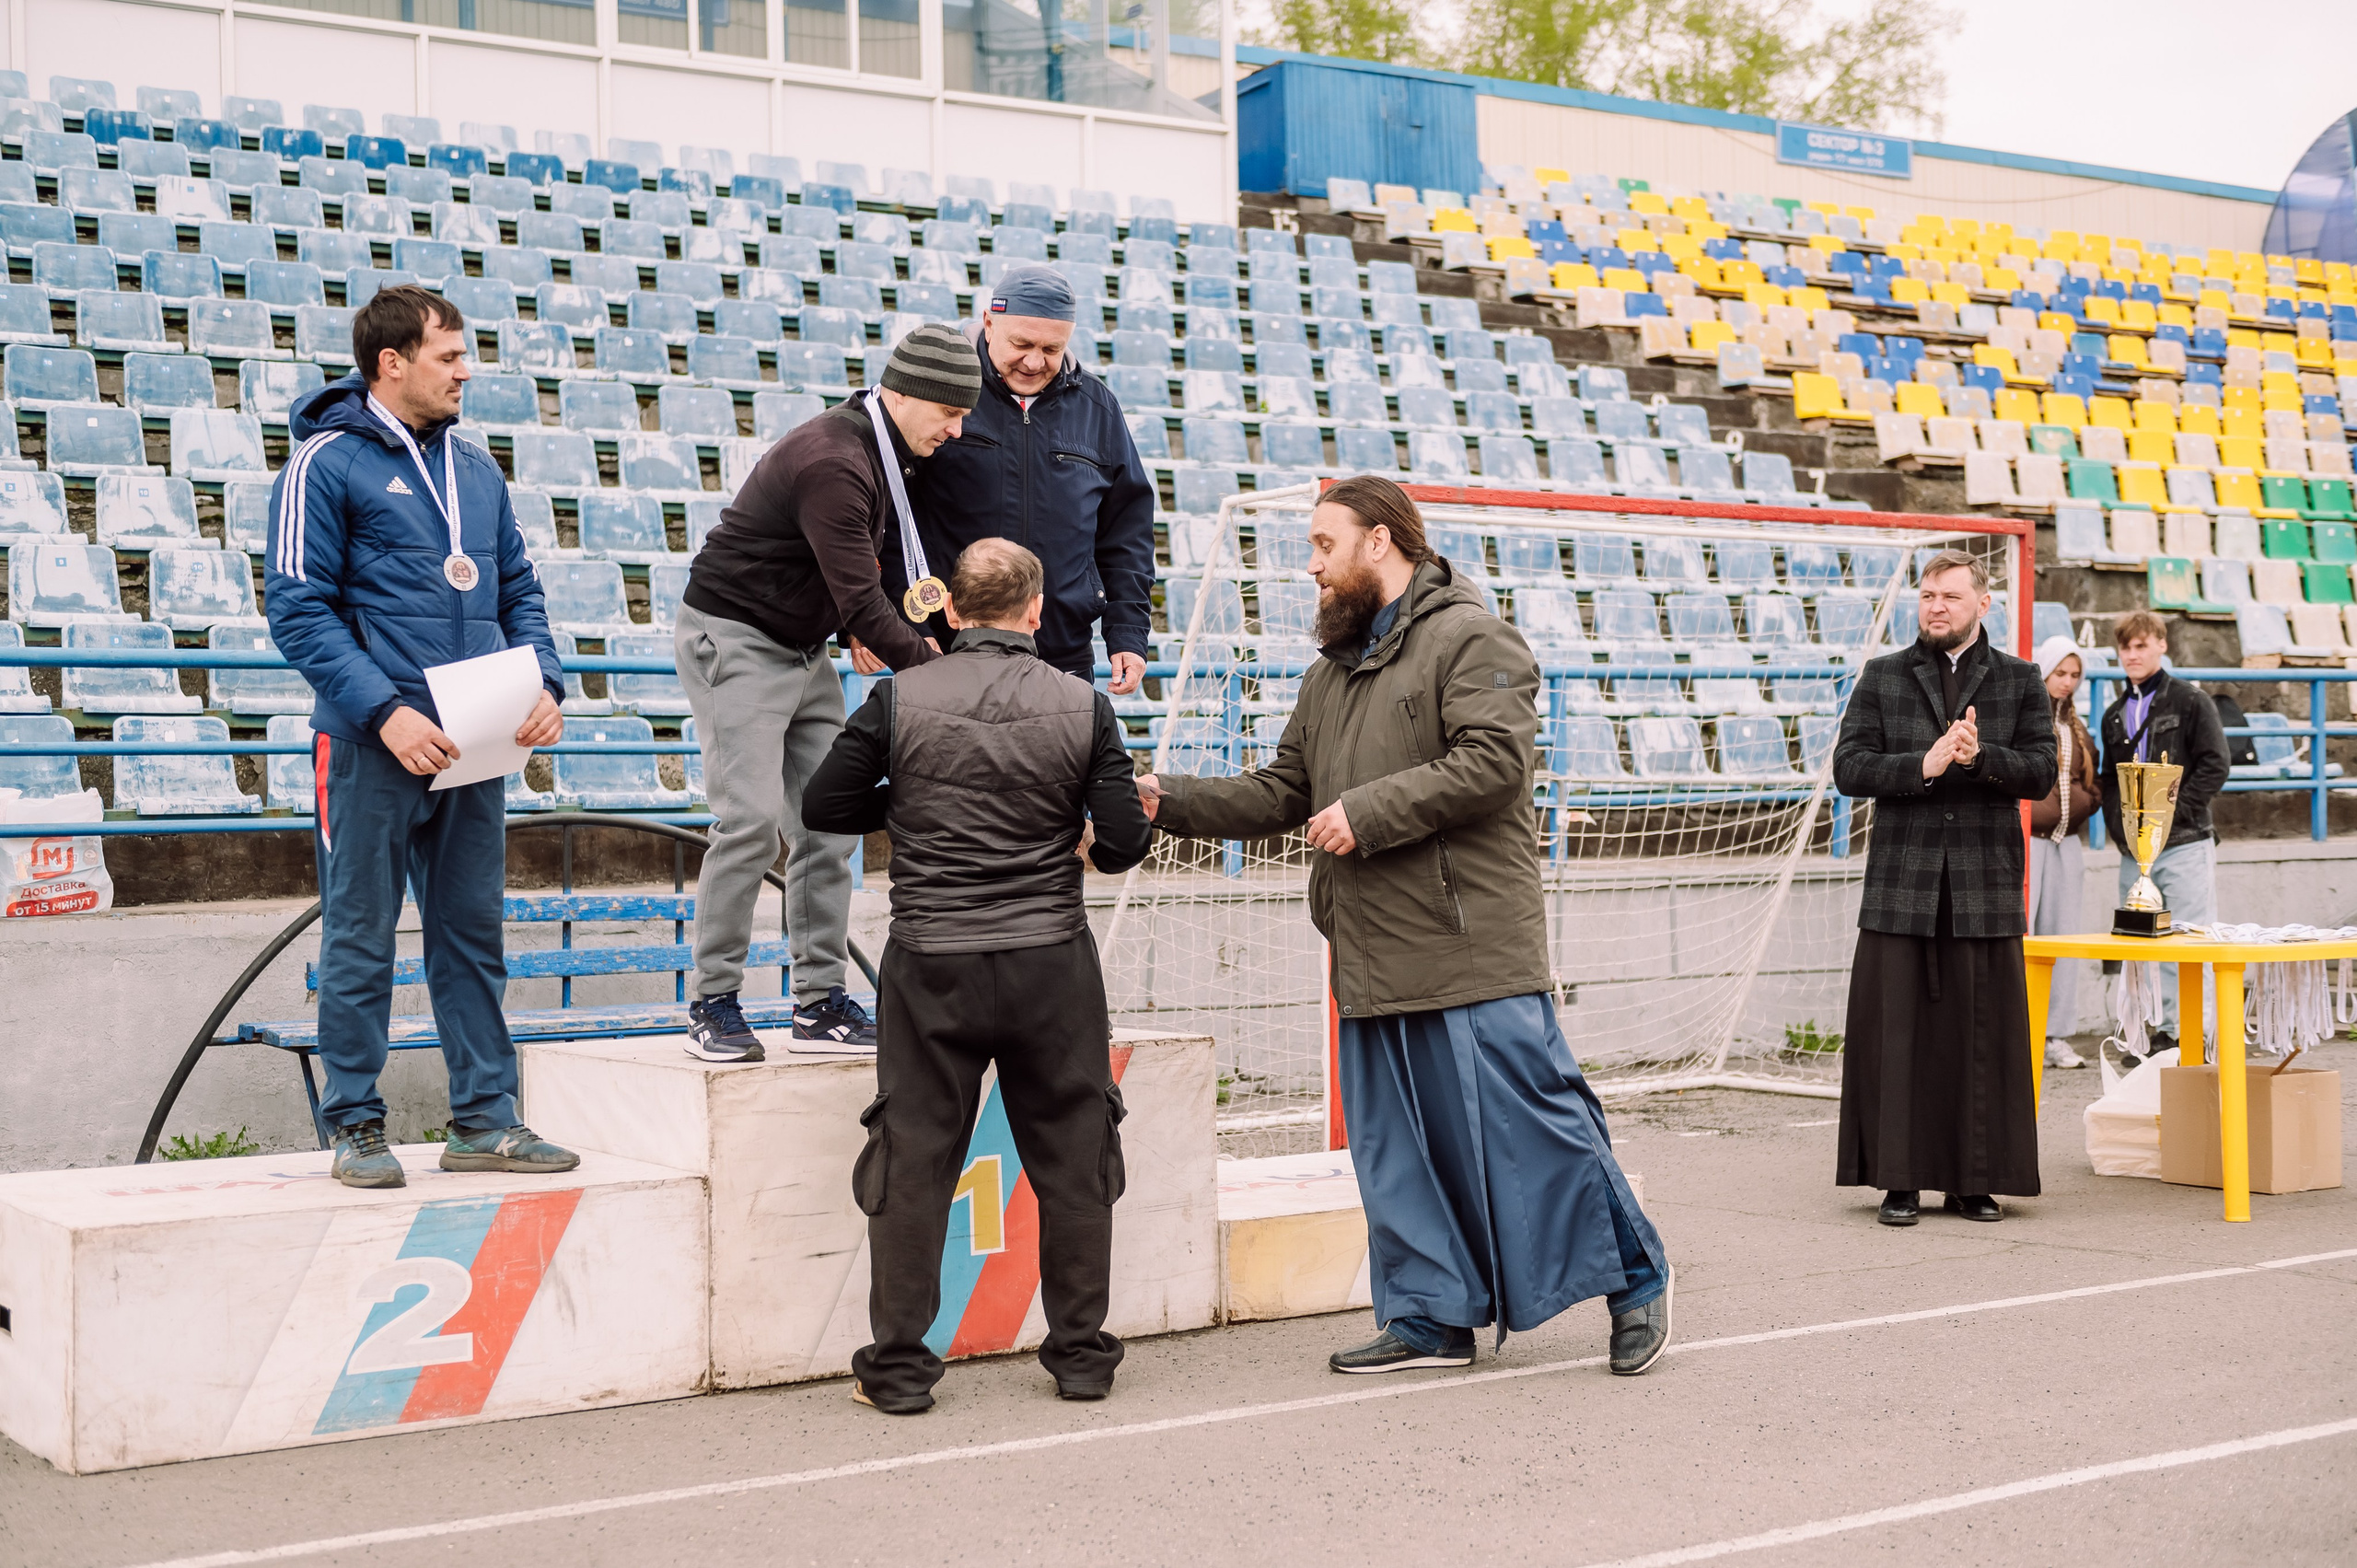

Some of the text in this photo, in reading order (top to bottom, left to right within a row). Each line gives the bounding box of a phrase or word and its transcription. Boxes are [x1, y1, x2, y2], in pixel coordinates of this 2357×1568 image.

[1807, 133, 1859, 152] СЕКТОР
[1807, 468, 1827, 494] 7
[42, 847, 62, 866] М
[20, 881, 87, 899] Доставка
[15, 897, 92, 916] от 15 минут
[952, 1154, 1005, 1256] 1
[346, 1256, 474, 1376] 2
